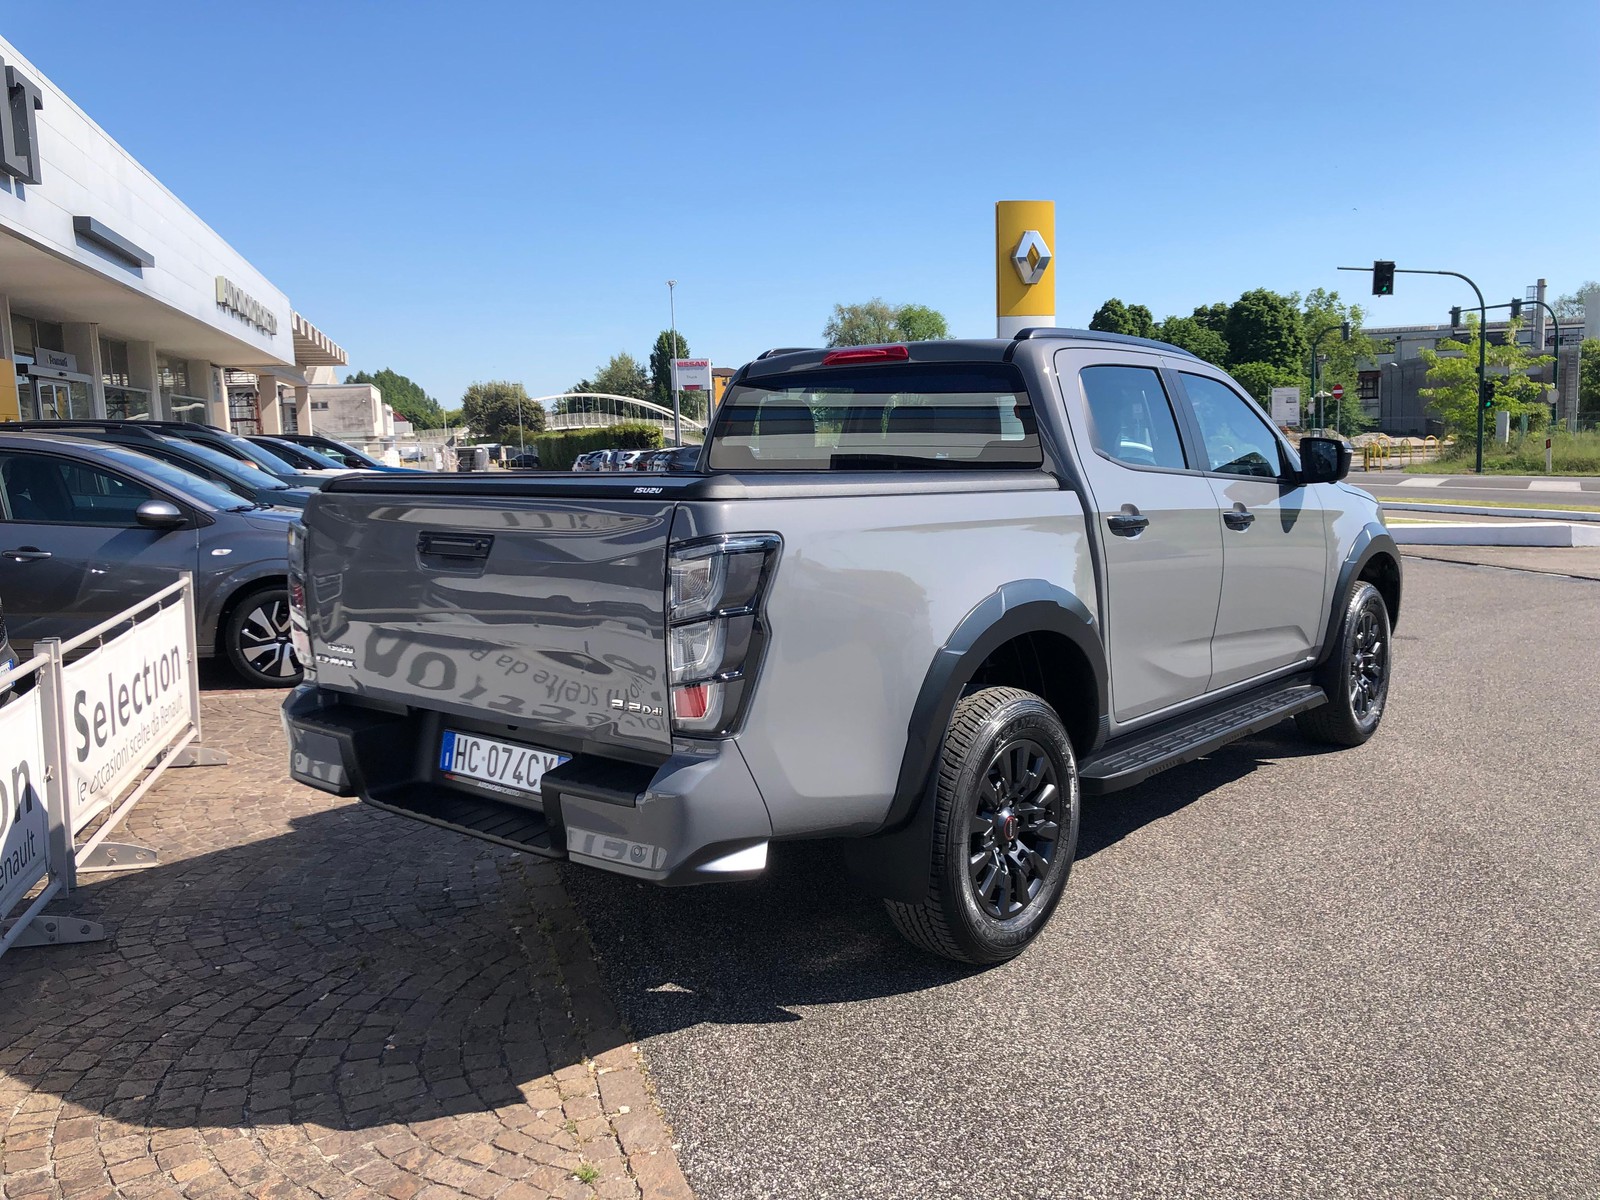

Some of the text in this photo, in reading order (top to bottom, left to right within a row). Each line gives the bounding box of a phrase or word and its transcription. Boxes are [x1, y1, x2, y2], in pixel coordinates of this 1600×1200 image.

[74, 645, 181, 763] Selection
[77, 777, 87, 806] le
[89, 738, 130, 795] occasioni
[129, 722, 151, 758] scelte
[151, 714, 160, 736] da
[454, 737, 480, 773] HC
